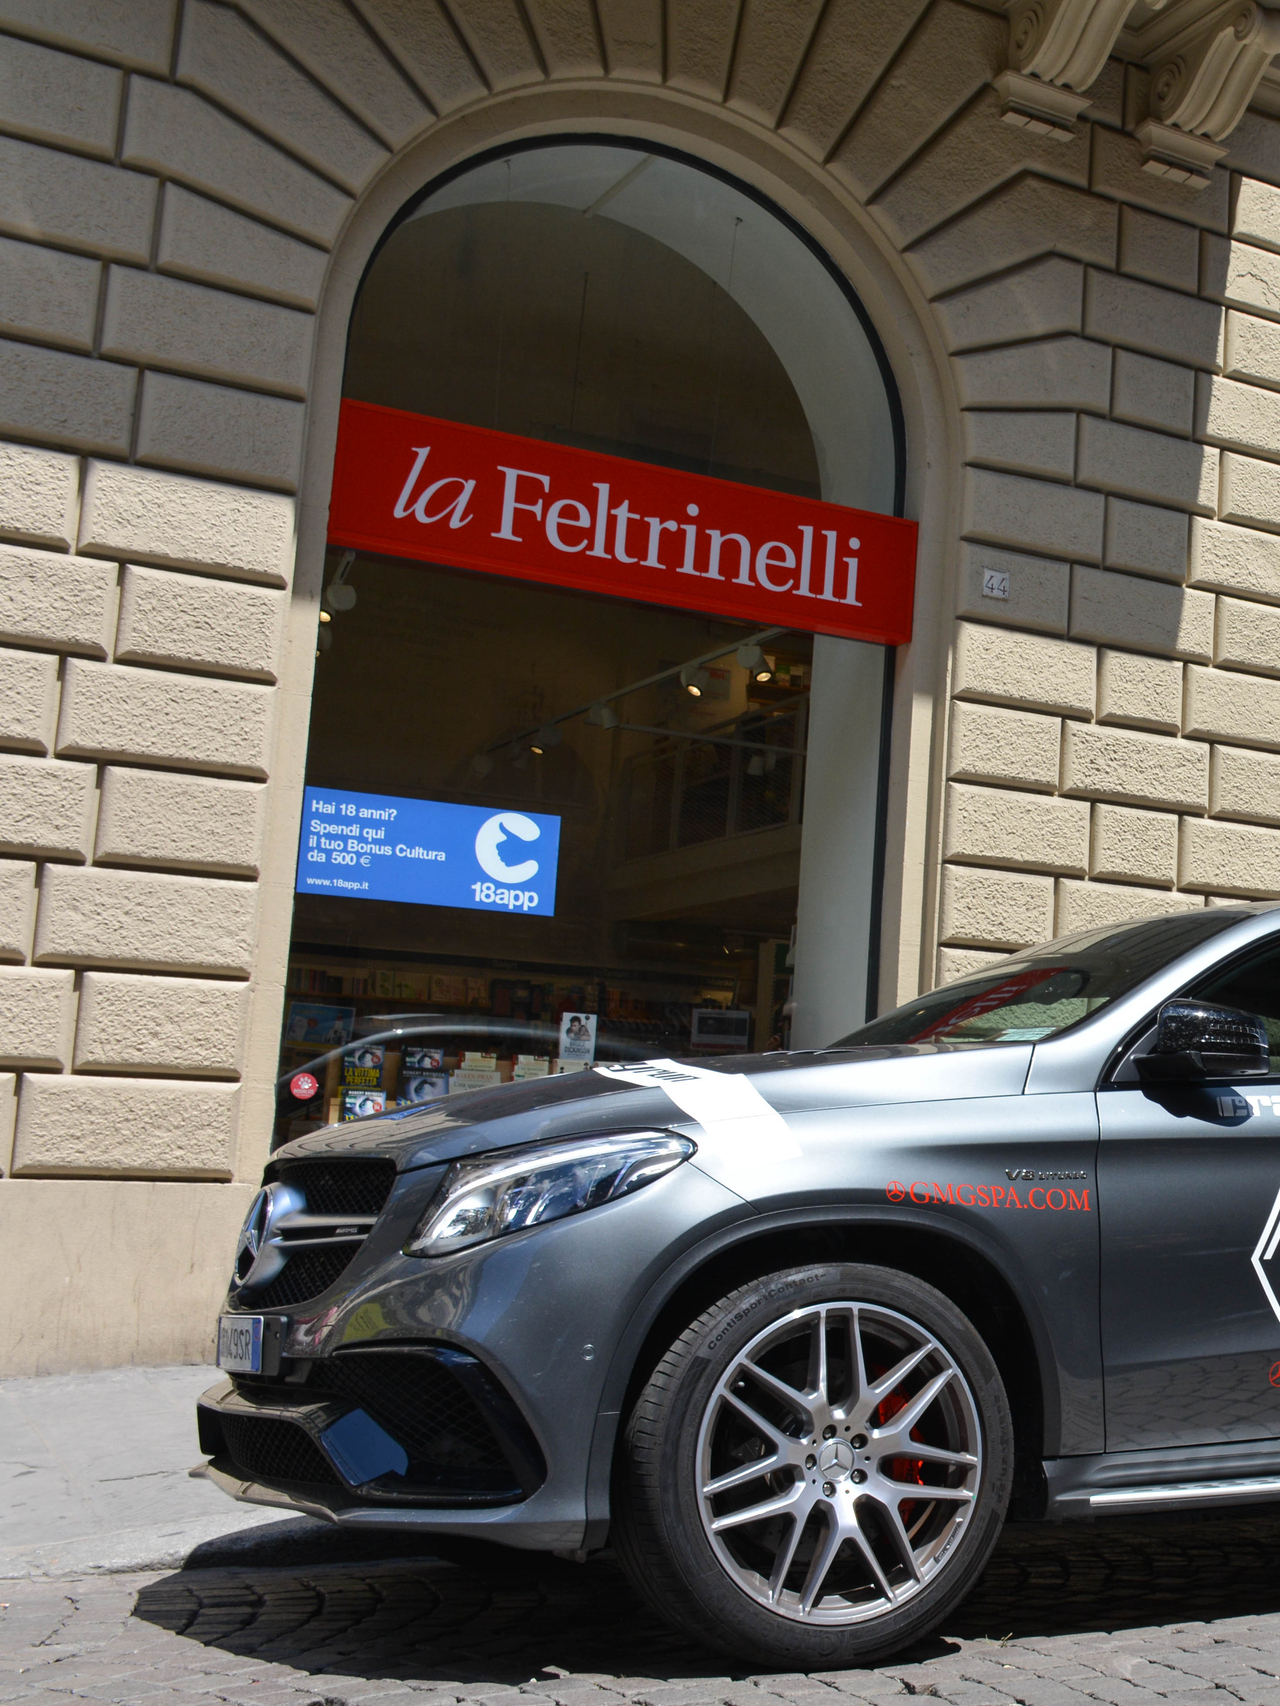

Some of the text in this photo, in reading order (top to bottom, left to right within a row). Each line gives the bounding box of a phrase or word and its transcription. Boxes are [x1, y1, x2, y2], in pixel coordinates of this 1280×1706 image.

[393, 446, 863, 607] la Feltrinelli
[985, 575, 1008, 596] 44
[311, 800, 397, 821] Hai 18 anni?
[310, 820, 385, 840] Spendi qui
[307, 849, 372, 867] da 500 €
[309, 835, 446, 861] il tuo Bonus Cultura
[306, 877, 369, 890] www.18app.it
[471, 881, 539, 911] 18app
[1005, 1169, 1035, 1180] V8
[909, 1180, 1092, 1211] GMGSPA.COM
